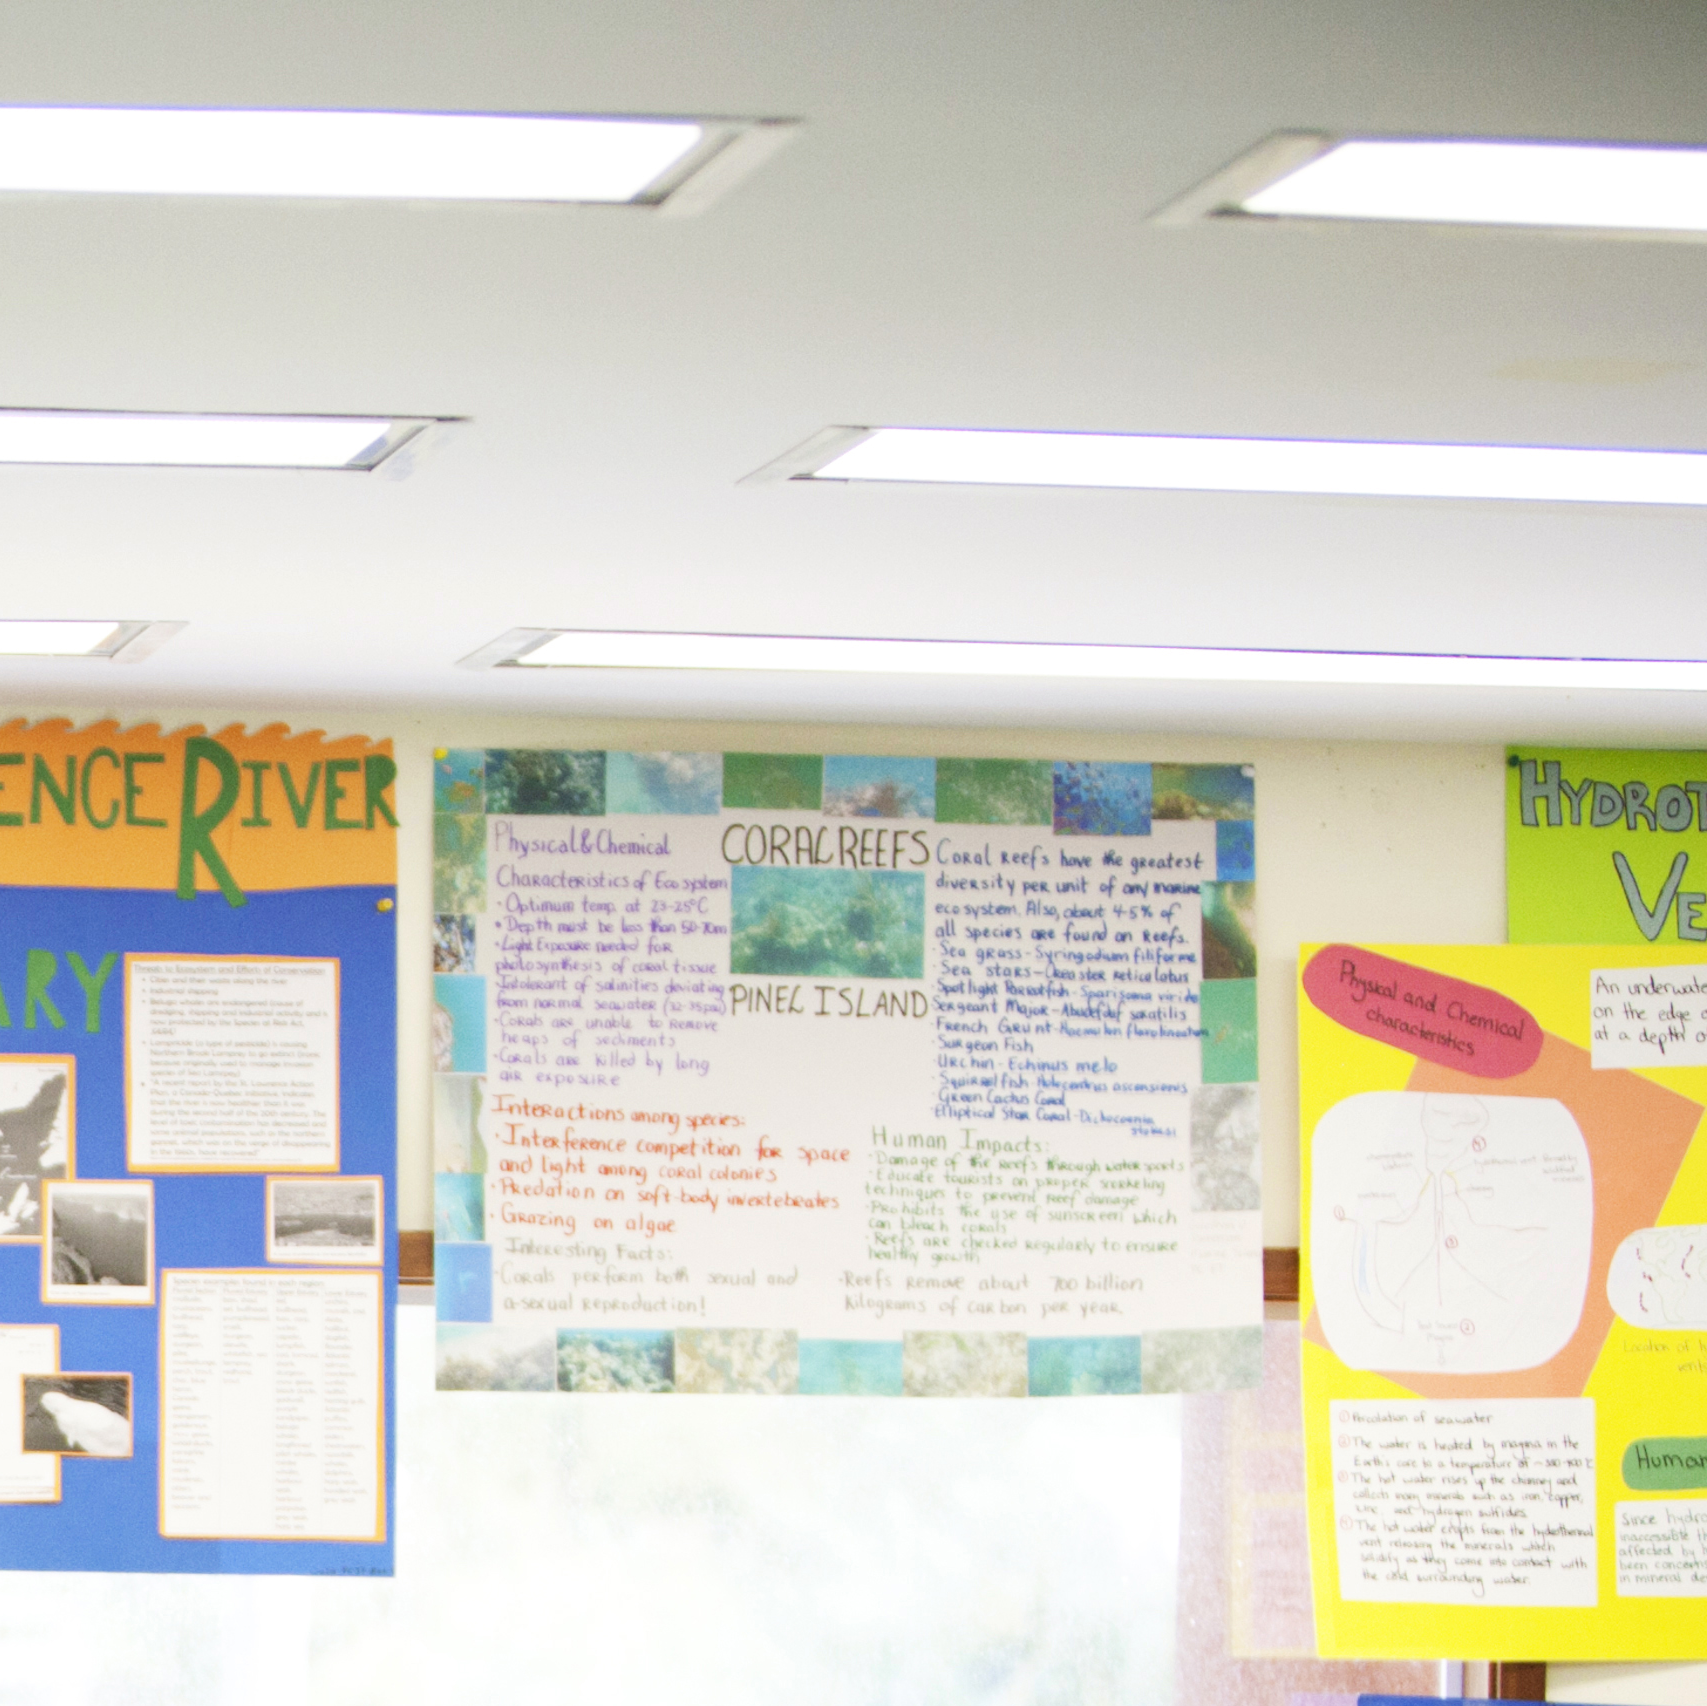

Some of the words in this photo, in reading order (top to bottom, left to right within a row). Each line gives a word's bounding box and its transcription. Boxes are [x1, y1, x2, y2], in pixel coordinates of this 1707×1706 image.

[177, 736, 400, 909] RIVER
[494, 821, 577, 859] Physical
[596, 825, 671, 856] Chemical
[839, 825, 930, 868] REEFS
[1060, 848, 1092, 868] have
[1103, 848, 1123, 869] the
[632, 871, 649, 891] of
[1338, 958, 1398, 1004] Physical
[1404, 988, 1437, 1015] and
[1446, 999, 1525, 1041] Chemical
[1596, 975, 1619, 995] An
[814, 986, 928, 1019] ISLAND
[1593, 1006, 1613, 1018] on
[1623, 1002, 1647, 1020] the
[1659, 1002, 1692, 1033] edge
[630, 1109, 680, 1135] among
[872, 1125, 947, 1151] Human
